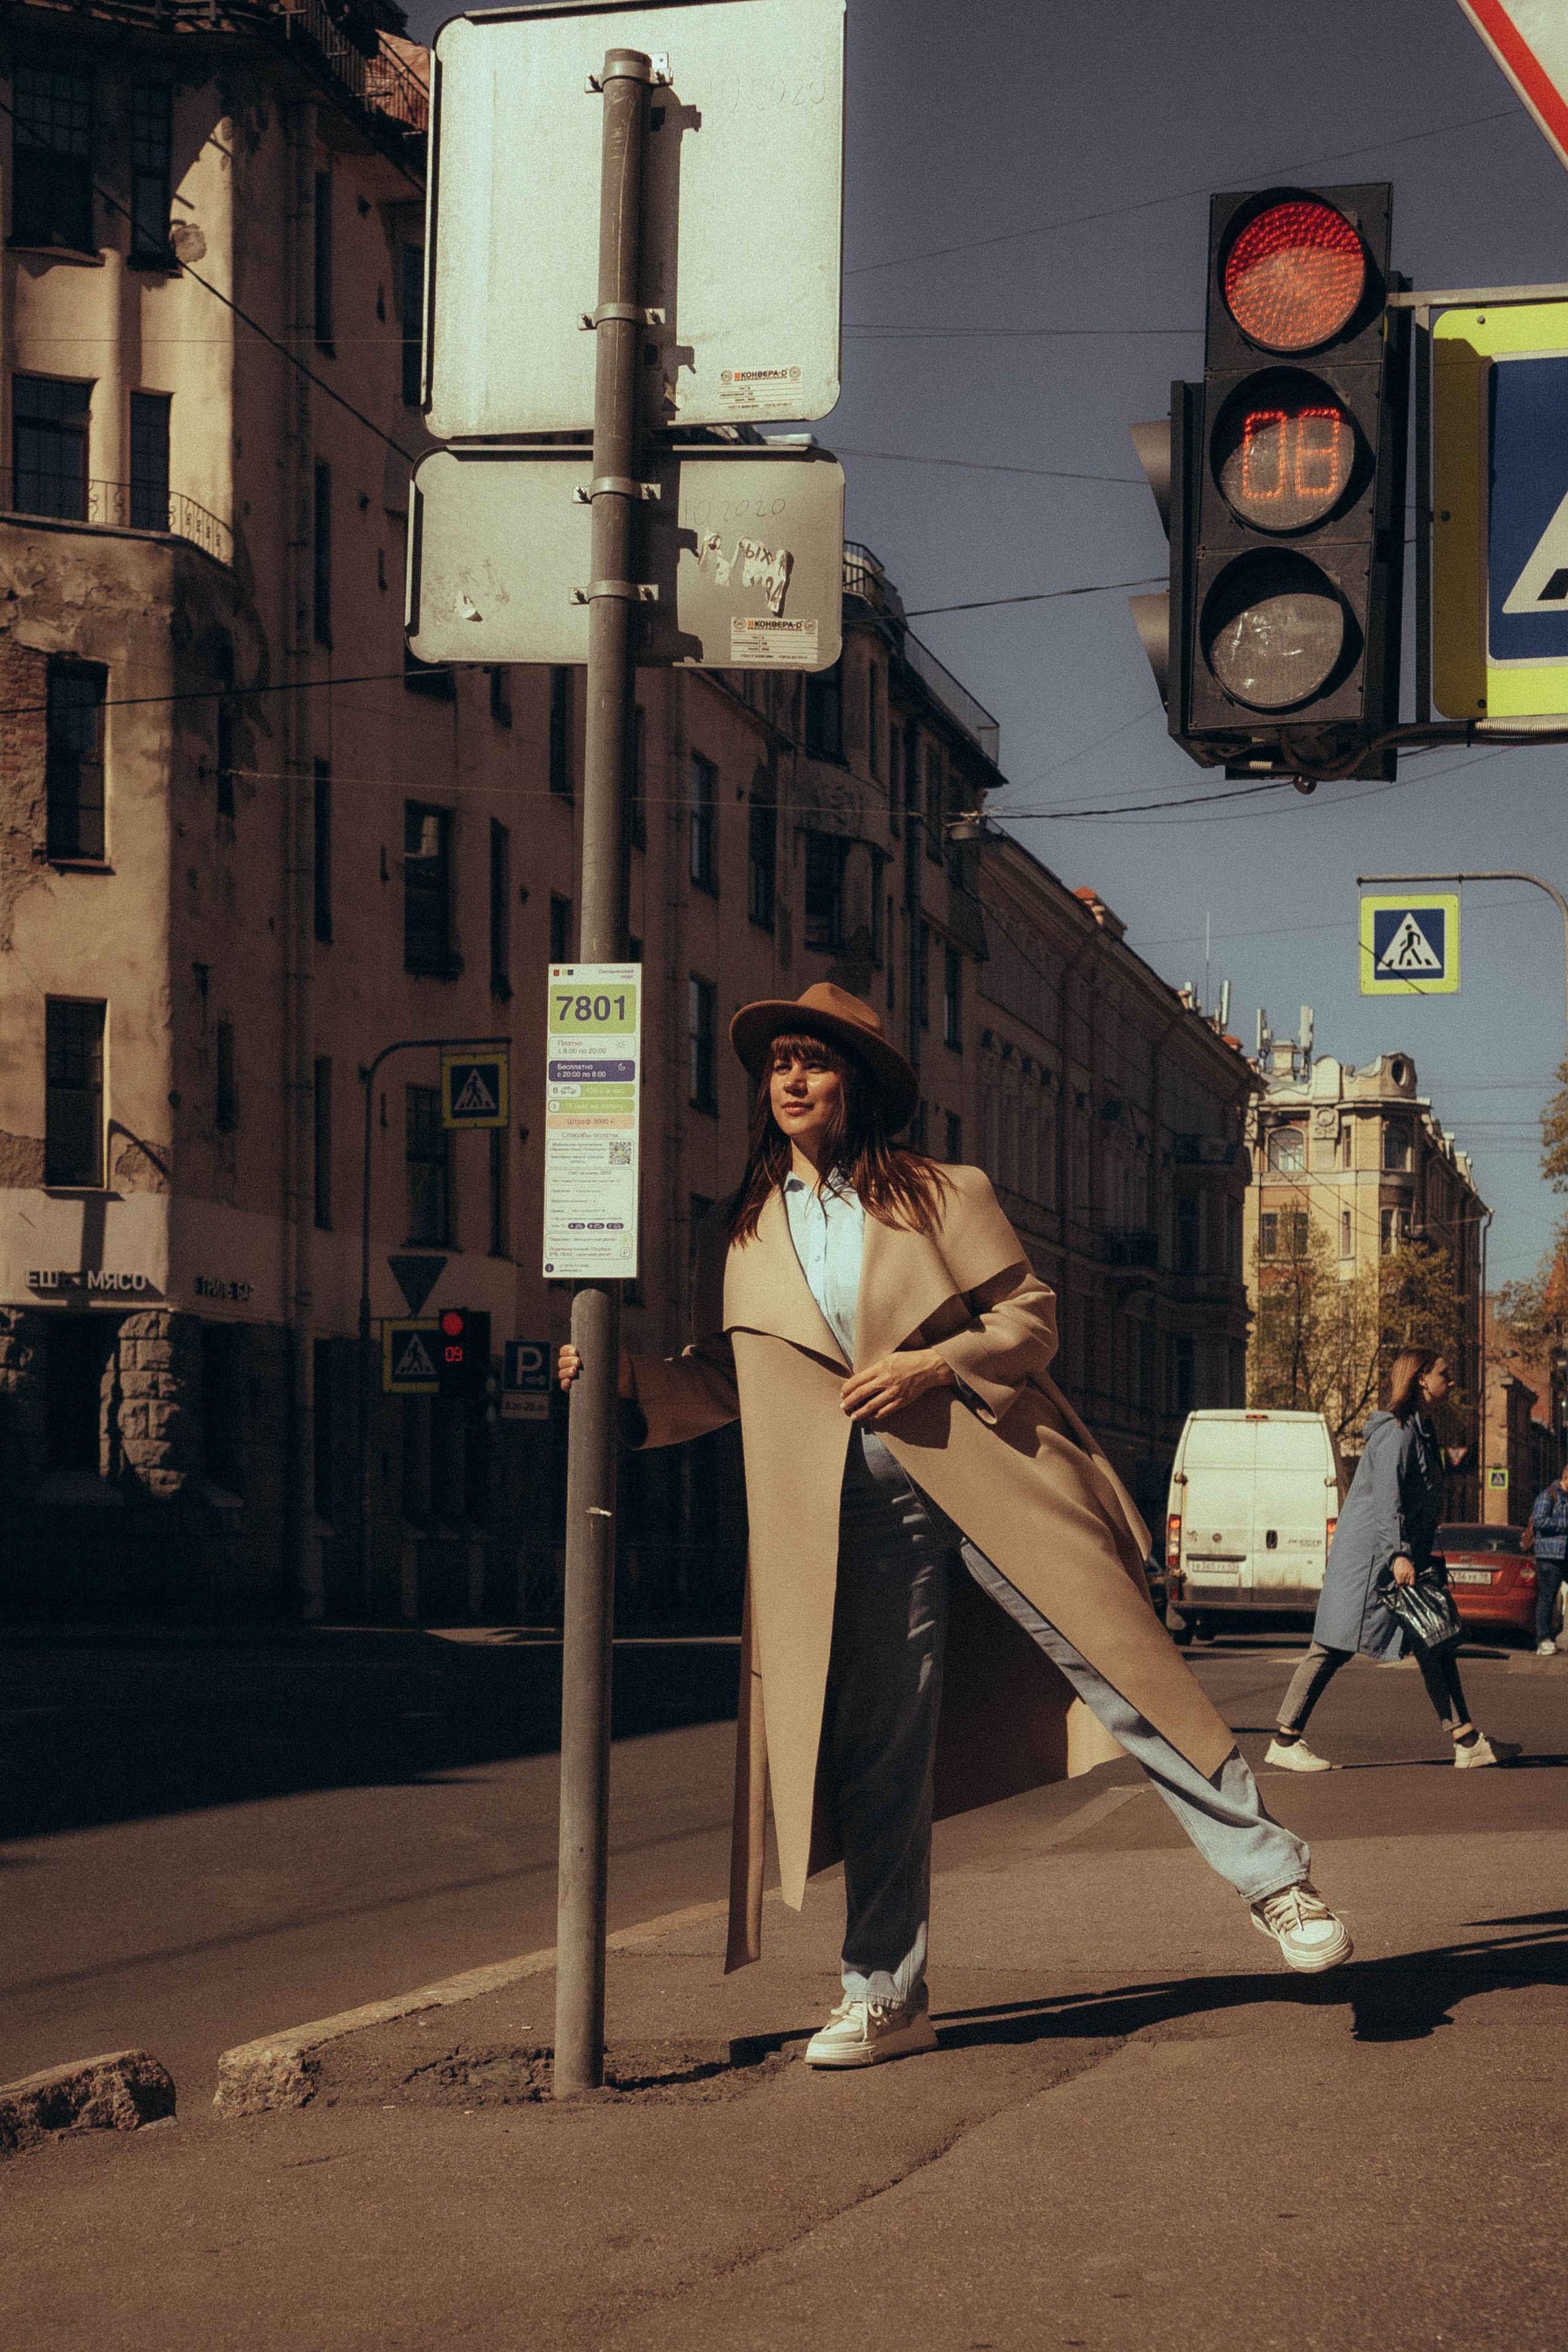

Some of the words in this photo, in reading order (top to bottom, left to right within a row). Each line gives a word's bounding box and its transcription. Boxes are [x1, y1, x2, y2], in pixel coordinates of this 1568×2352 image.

[1242, 406, 1341, 499] 08
[556, 995, 625, 1021] 7801
[26, 1270, 60, 1287] ЕШ
[87, 1270, 146, 1291] МЯСО
[445, 1346, 463, 1362] 09
[516, 1346, 543, 1385] P
